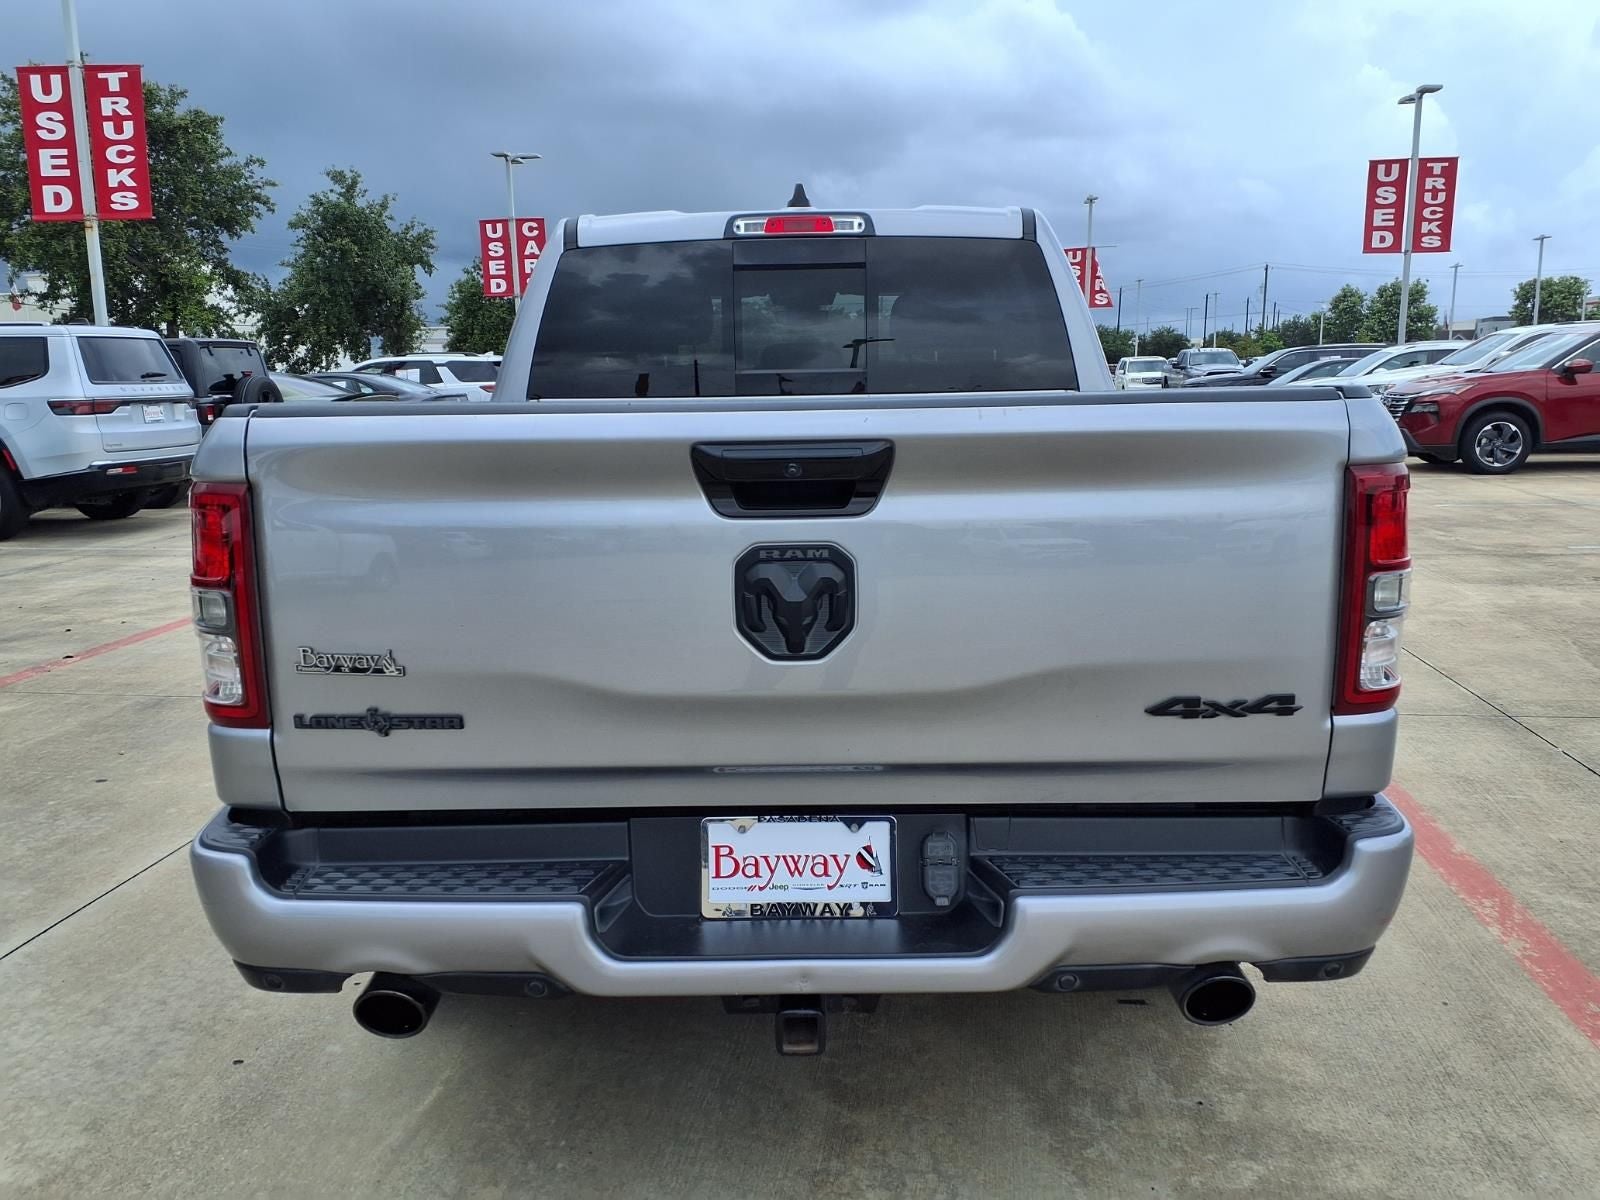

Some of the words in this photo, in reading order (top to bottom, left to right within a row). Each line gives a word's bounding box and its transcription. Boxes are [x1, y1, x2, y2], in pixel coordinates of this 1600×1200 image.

[29, 74, 73, 213] USED
[97, 71, 139, 211] TRUCKS
[1371, 163, 1400, 249] USED
[1420, 162, 1449, 248] TRUCKS
[485, 223, 507, 293] USED
[521, 221, 541, 285] CAR
[759, 549, 829, 558] RAM
[297, 647, 380, 674] Bayway
[294, 714, 364, 729] LONE
[388, 714, 464, 729] STAR
[711, 844, 851, 891] Bayway
[769, 883, 789, 891] Jeep
[750, 902, 851, 917] BAYWAY
